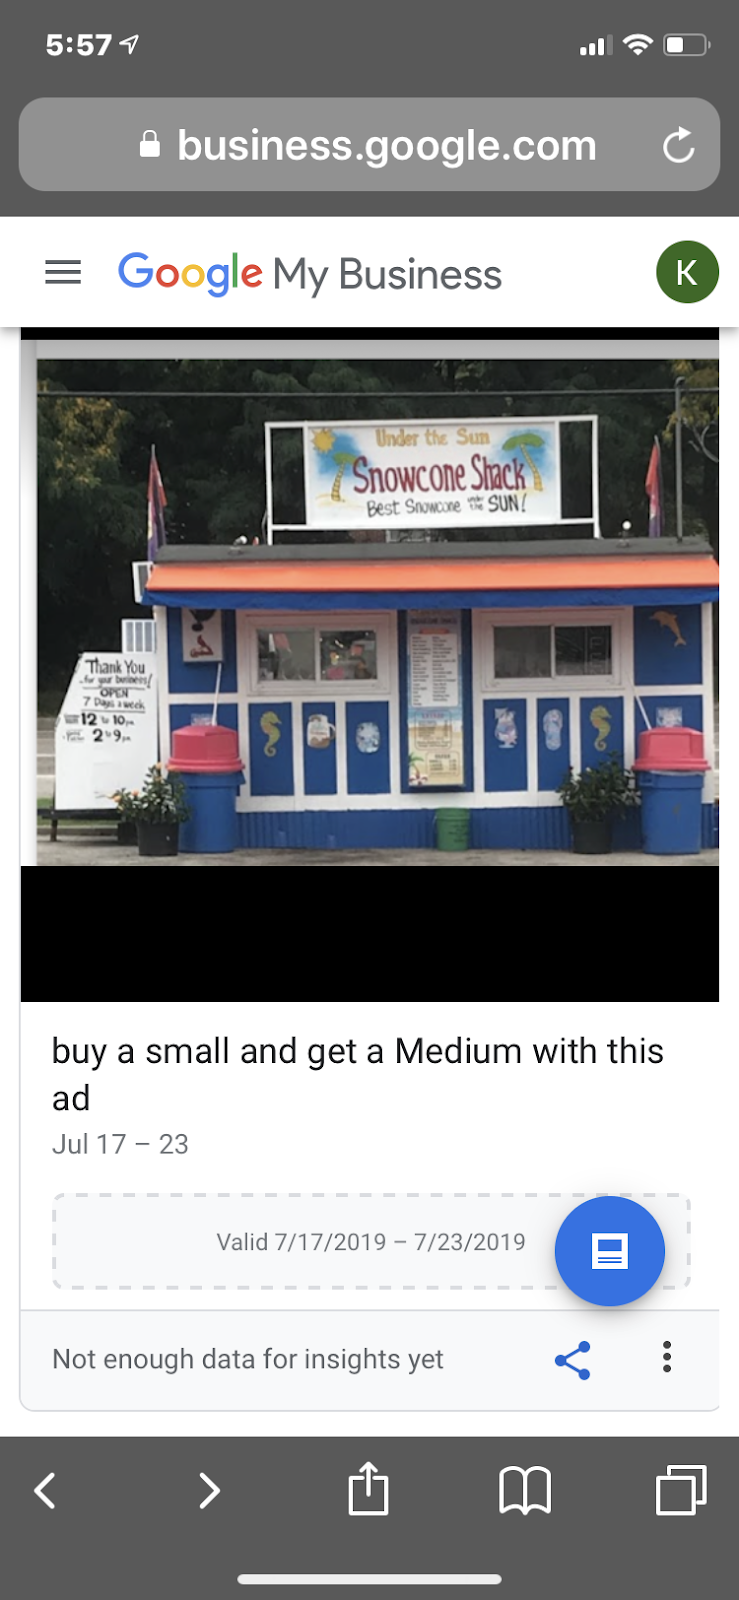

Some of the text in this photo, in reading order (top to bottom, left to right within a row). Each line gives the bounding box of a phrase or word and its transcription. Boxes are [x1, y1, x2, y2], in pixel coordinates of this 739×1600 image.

[46, 34, 112, 56] 5:57
[179, 128, 596, 168] business.google.com
[118, 252, 502, 298] Google My Business
[678, 259, 698, 286] K
[375, 427, 491, 447] Under the Sun
[352, 453, 527, 494] Snowcone Shack
[367, 500, 401, 518] Best
[405, 498, 461, 514] Snowcone
[488, 493, 527, 513] SUN!
[84, 656, 145, 675] Thank You
[83, 696, 91, 706] 7
[94, 697, 115, 710] Days
[100, 688, 129, 699] OPEN
[81, 711, 98, 726] 12
[92, 728, 103, 742] 2
[53, 1036, 663, 1071] buy a small and get a Medium with this
[53, 1084, 90, 1111] ad
[52, 1133, 88, 1155] Jul
[97, 1133, 126, 1155] 17
[160, 1133, 188, 1155] 23
[217, 1232, 268, 1251] Valid
[275, 1233, 386, 1252] 7/17/2019
[415, 1233, 525, 1252] 7/23/2019
[53, 1347, 444, 1374] Not enough data for insights yet
